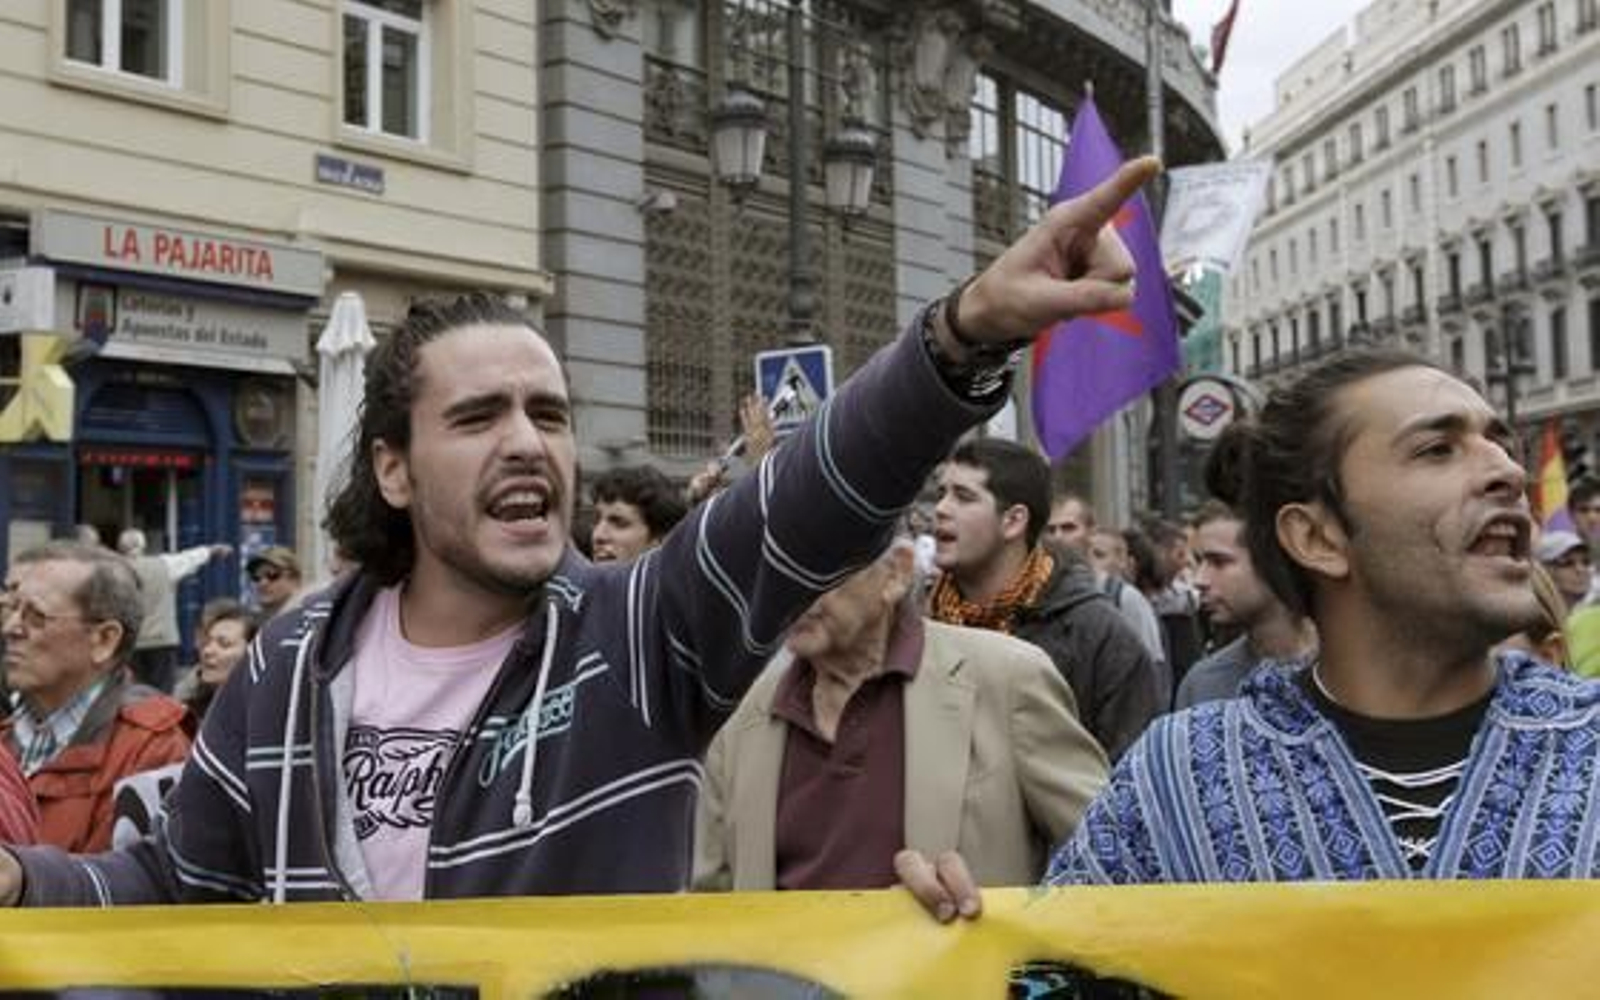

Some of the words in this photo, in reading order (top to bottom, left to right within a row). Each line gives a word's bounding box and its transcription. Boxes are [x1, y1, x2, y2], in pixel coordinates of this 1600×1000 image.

[103, 226, 140, 262] LA
[155, 232, 273, 280] PAJARITA
[342, 750, 445, 815] Ralph
